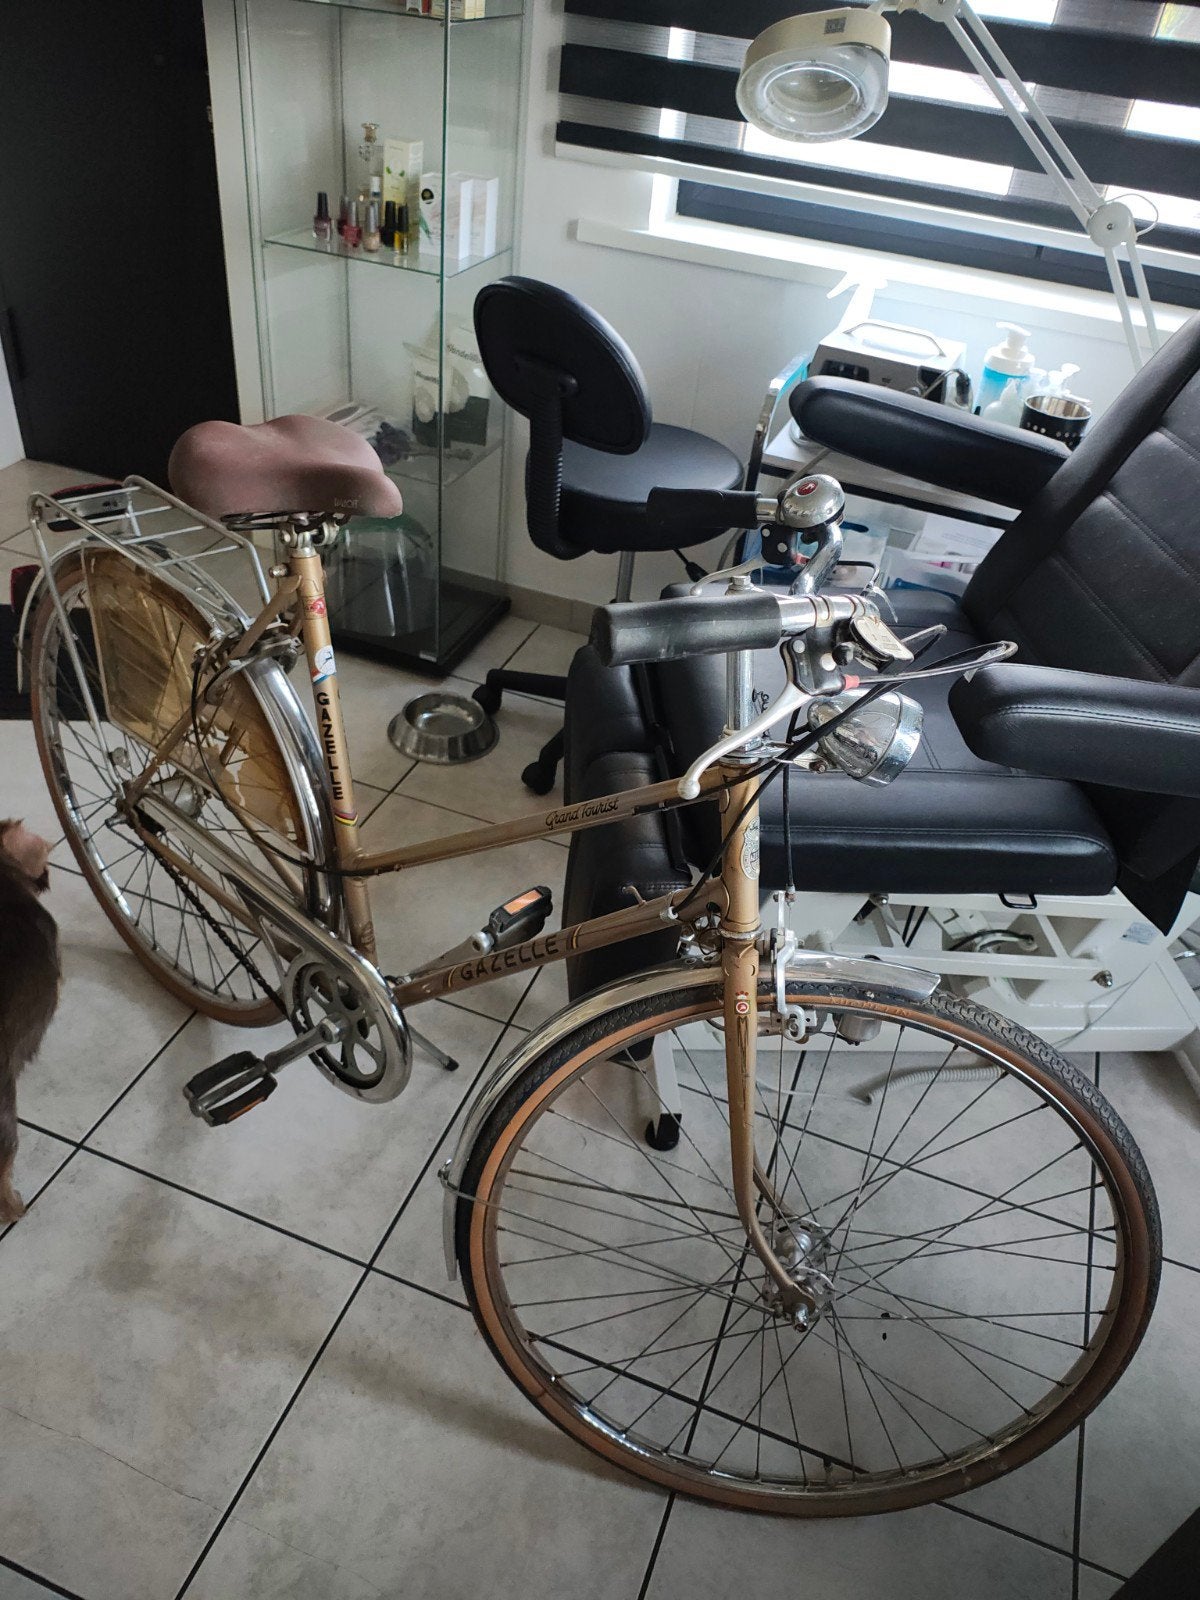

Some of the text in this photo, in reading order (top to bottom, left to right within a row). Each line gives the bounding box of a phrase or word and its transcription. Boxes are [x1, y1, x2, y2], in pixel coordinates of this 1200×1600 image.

[316, 692, 344, 800] GAZELLE
[545, 798, 620, 830] Grand Tourist
[460, 933, 559, 981] GAZELLE
